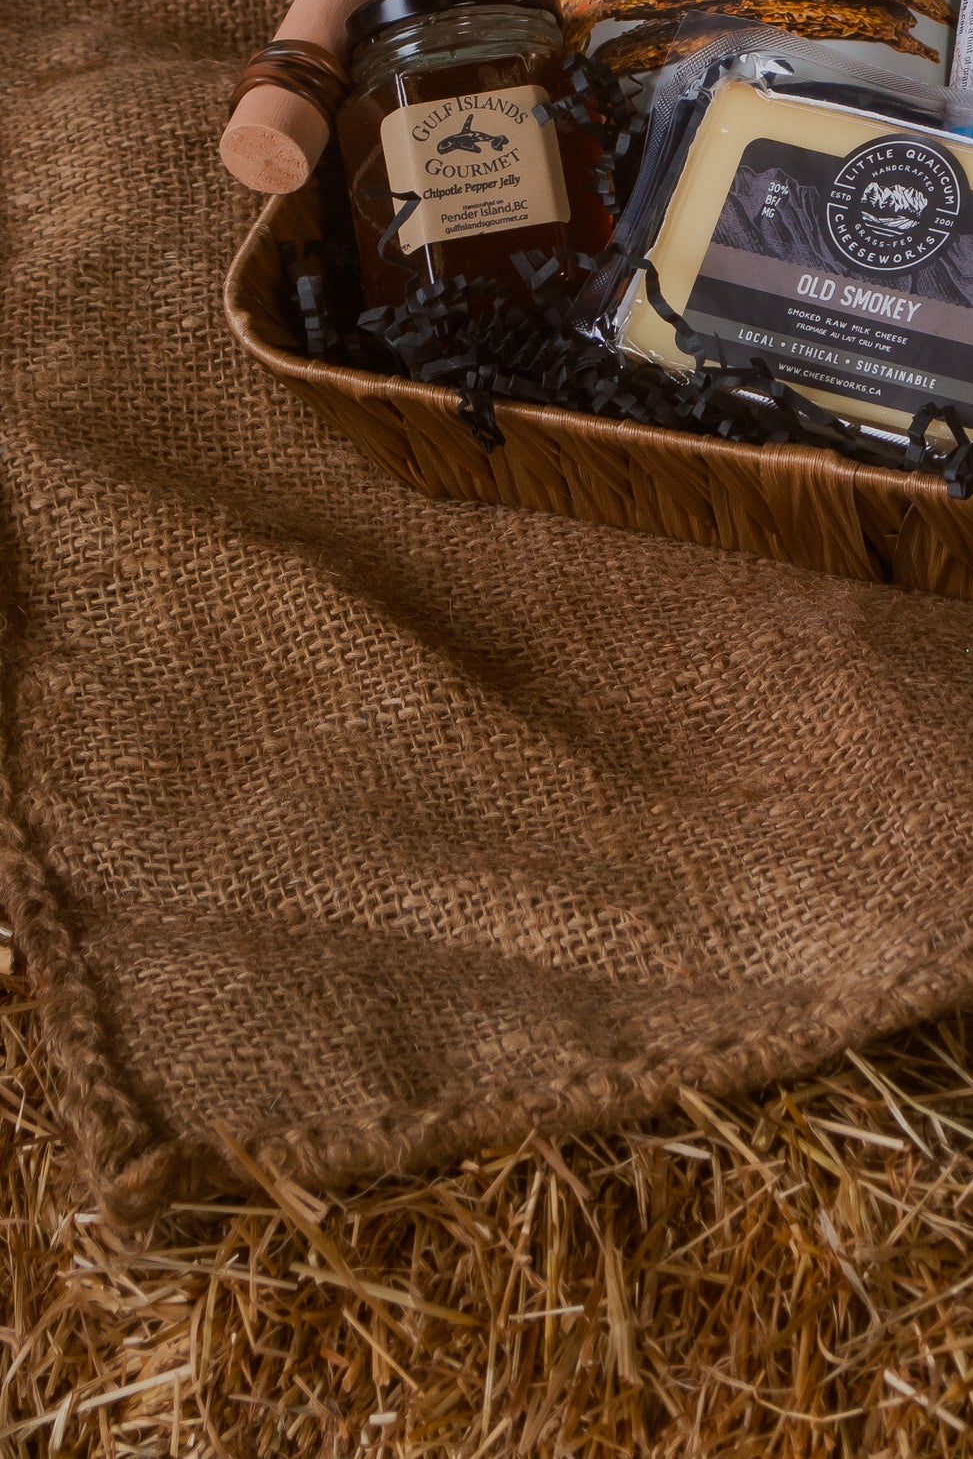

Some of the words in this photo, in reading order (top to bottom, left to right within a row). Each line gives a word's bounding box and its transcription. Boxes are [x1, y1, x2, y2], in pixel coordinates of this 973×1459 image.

[964, 56, 973, 68] of
[411, 102, 454, 142] GULF
[456, 96, 528, 125] ISLANDS
[425, 148, 521, 179] GOURMET
[845, 149, 893, 181] LITTLE
[906, 149, 954, 205] QUALICUM
[423, 184, 462, 200] Chipotle
[465, 180, 497, 194] Pepper
[499, 174, 520, 189] Jelly
[768, 182, 789, 195] 30%
[872, 164, 935, 192] HANDCRAFTED
[441, 210, 478, 224] Pender
[463, 200, 496, 210] Handcrafted
[761, 206, 775, 218] MG
[830, 191, 852, 201] ESTD
[934, 217, 954, 227] 2001
[445, 214, 528, 234] gulfislandsgourmet.ca
[855, 223, 913, 248] GRASS-FED
[835, 213, 936, 264] CHEESEWORKS
[796, 274, 836, 301] OLD
[840, 285, 921, 323] SMOKEY
[787, 307, 821, 322] SMOKED
[825, 317, 847, 329] RAW
[851, 324, 871, 335] MILK
[874, 330, 909, 345] CHEESE
[796, 322, 828, 336] FROMAGE
[829, 331, 841, 339] AU
[841, 334, 857, 344] LAIT
[858, 338, 874, 348] CRU
[738, 328, 775, 347] LOCAL
[790, 342, 839, 365] ETHICAL
[856, 360, 937, 389] SUSTAINABLE
[778, 362, 882, 396] WWW.CHEESEWORKS.CA
